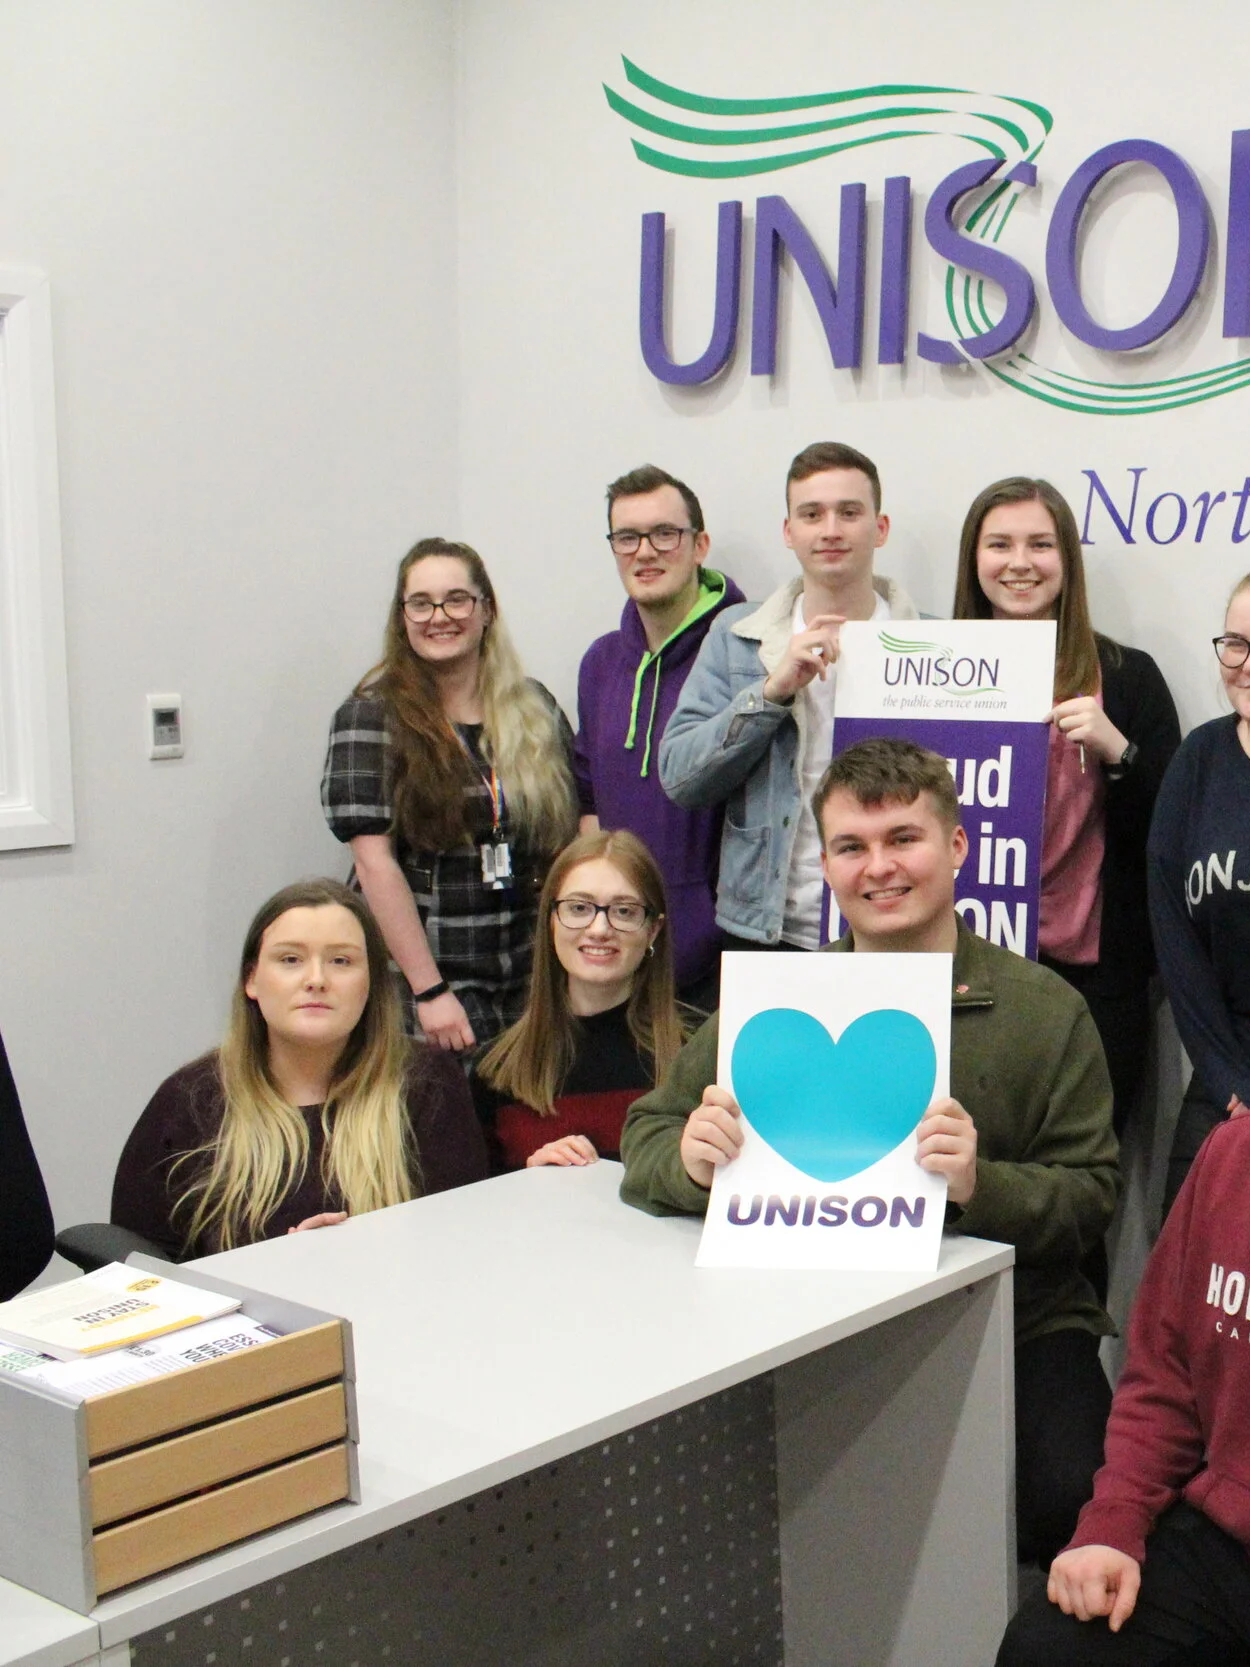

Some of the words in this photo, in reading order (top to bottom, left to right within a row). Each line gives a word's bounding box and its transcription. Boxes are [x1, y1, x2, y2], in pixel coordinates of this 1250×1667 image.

[884, 657, 999, 687] UNISON
[882, 694, 899, 707] the
[900, 694, 931, 711] public
[935, 697, 972, 709] service
[974, 698, 1008, 709] union
[978, 821, 1027, 886] in
[727, 1194, 926, 1228] UNISON
[73, 1298, 141, 1321] UNISON
[110, 1301, 149, 1317] STAY
